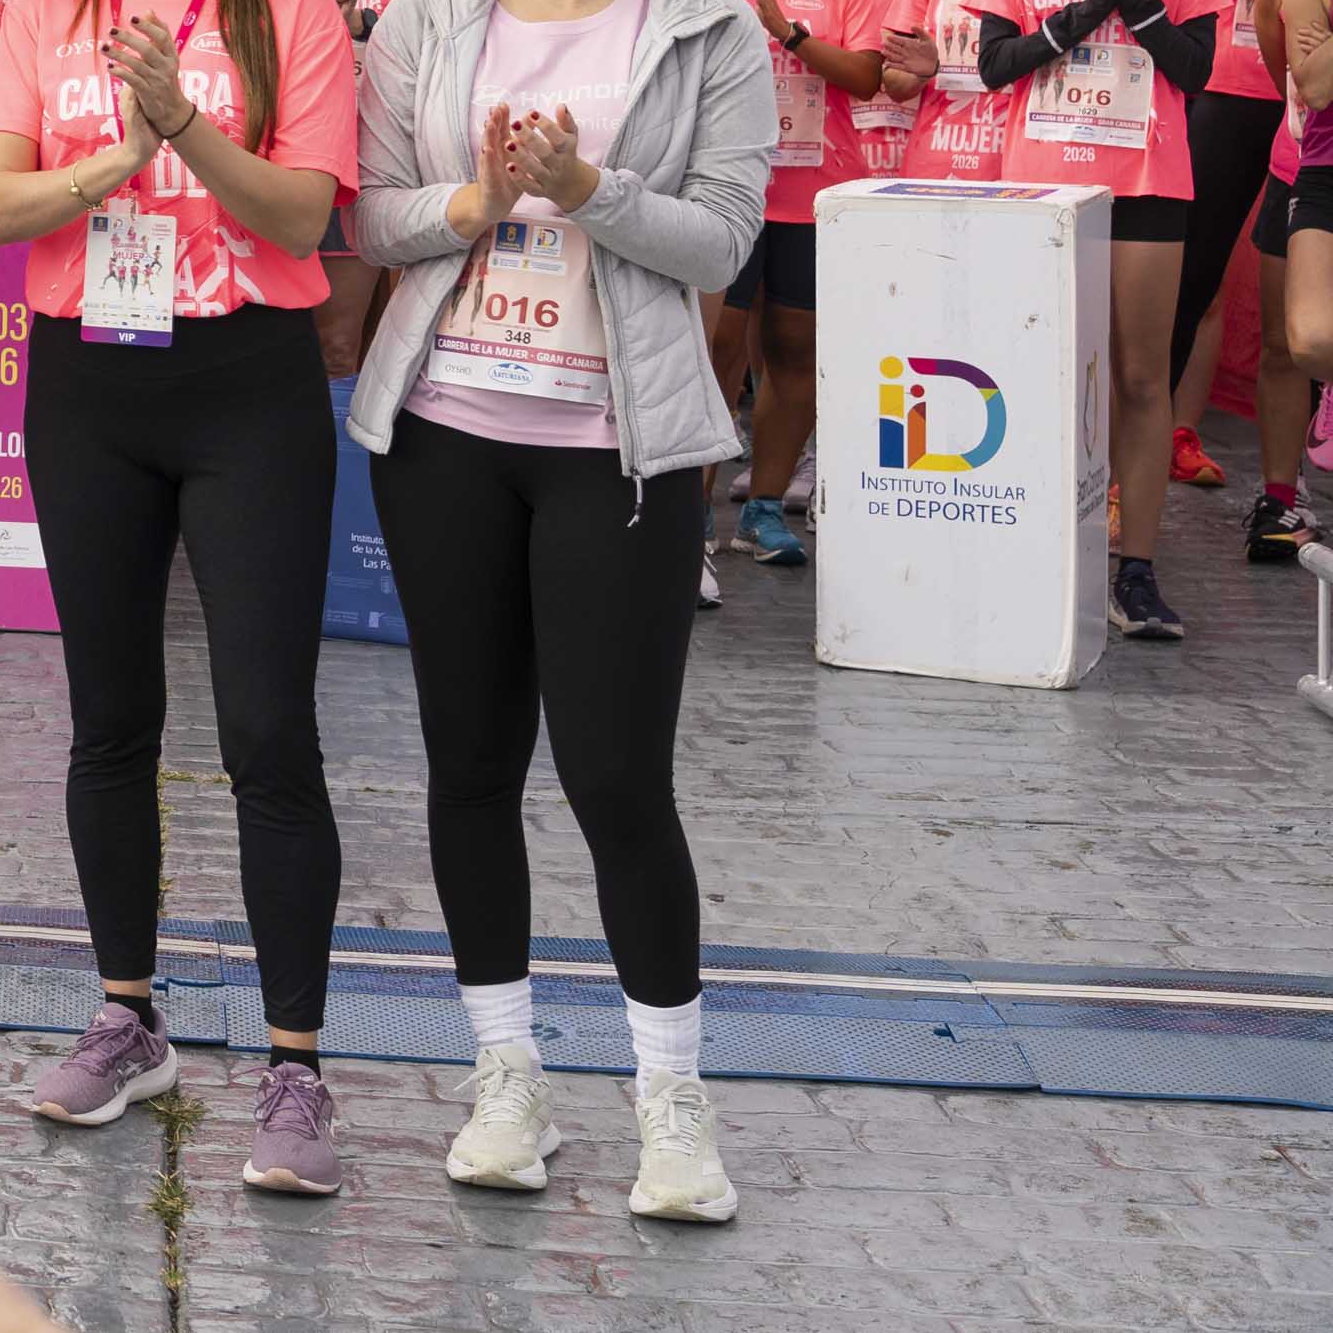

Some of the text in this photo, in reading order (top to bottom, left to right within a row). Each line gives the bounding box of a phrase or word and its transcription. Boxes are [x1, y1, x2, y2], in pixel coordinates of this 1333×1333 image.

[56, 38, 111, 59] OYS
[59, 69, 235, 122] CARA
[1067, 87, 1112, 106] 016
[1064, 147, 1095, 163] 2026
[485, 293, 560, 328] 016
[118, 332, 136, 342] VIP
[505, 329, 531, 345] 348
[438, 338, 604, 371] CARRERA DE LA MUJER GRAN CANARIA
[860, 471, 1026, 502] INSTITUTO INSULAR
[868, 498, 1018, 527] DE DEPORTES
[351, 532, 385, 546] Instituto
[352, 544, 364, 555] de
[365, 545, 373, 556] la
[363, 558, 379, 570] Las
